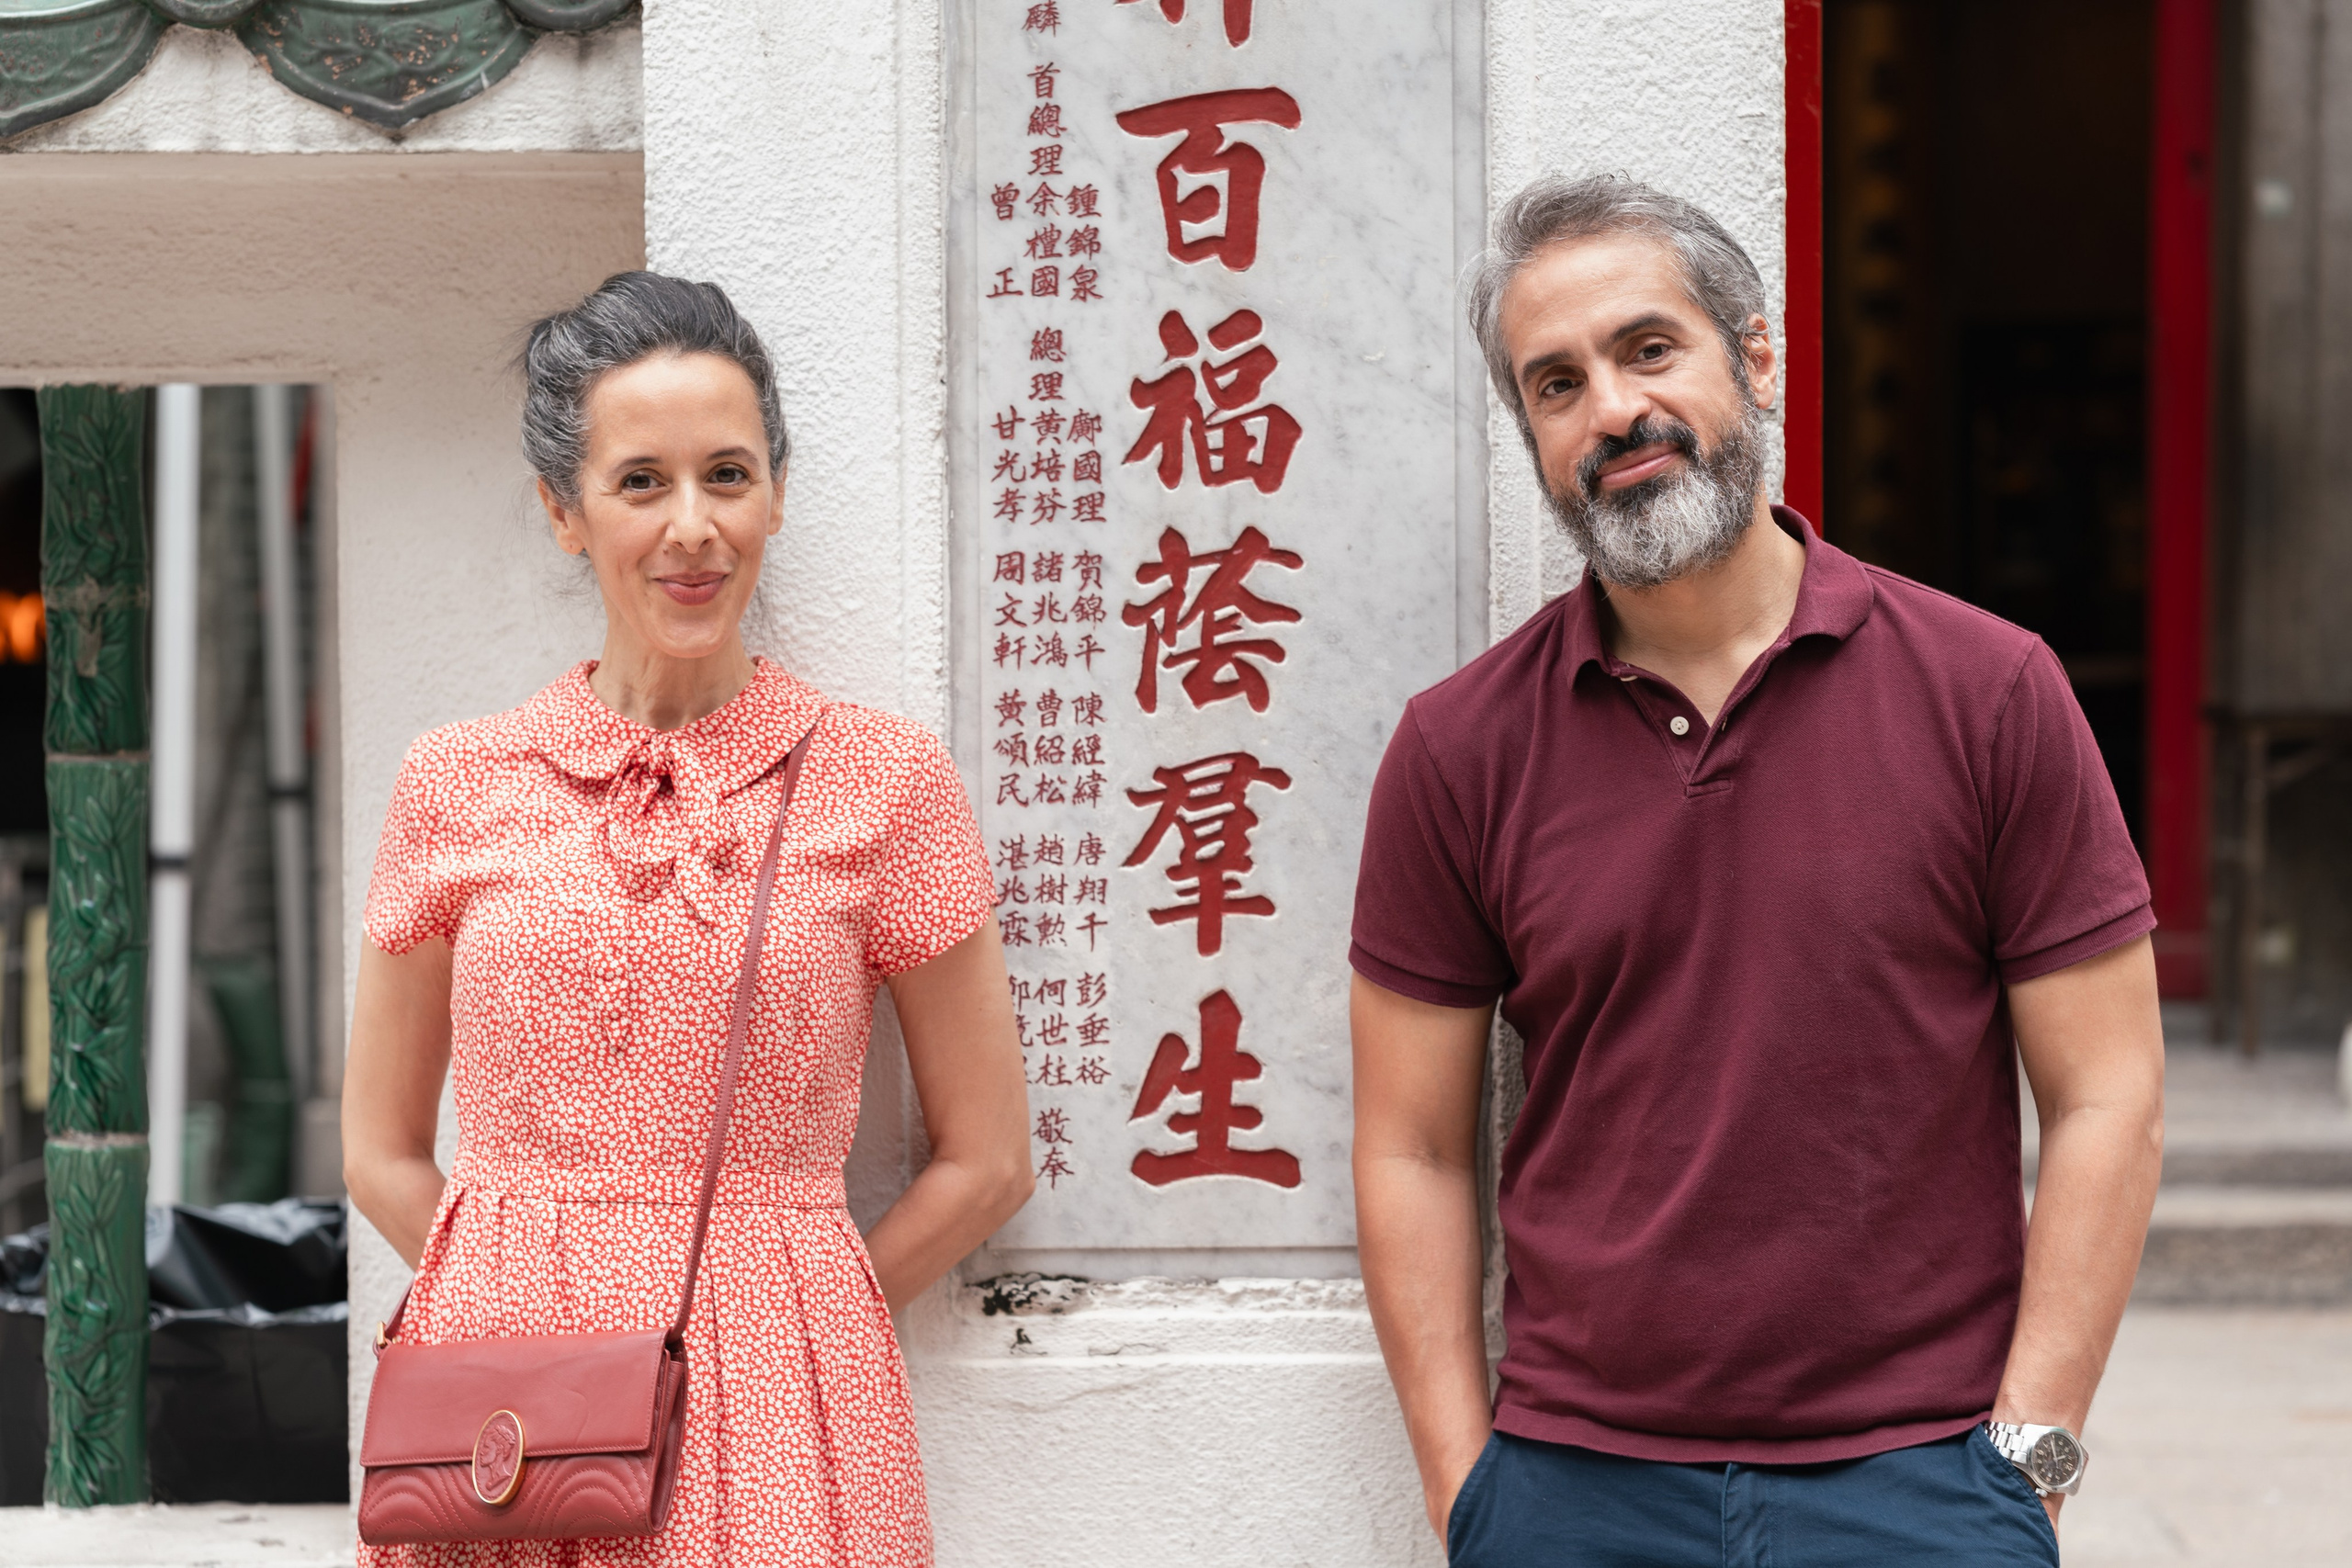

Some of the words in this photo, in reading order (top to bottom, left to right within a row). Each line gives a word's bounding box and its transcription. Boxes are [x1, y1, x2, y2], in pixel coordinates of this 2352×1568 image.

[1063, 183, 1105, 304] 鍾錦泉
[992, 549, 1028, 671] 周文軒
[1069, 549, 1108, 672] 賀錦平
[1114, 0, 1304, 1190] 百福蔭羣生
[1031, 687, 1068, 806] 曹紹松
[1069, 690, 1108, 809] 陳經緯
[1072, 830, 1109, 953] 唐翔千
[1033, 976, 1073, 1087] 何世柱
[1031, 1107, 1075, 1191] 敬奉
